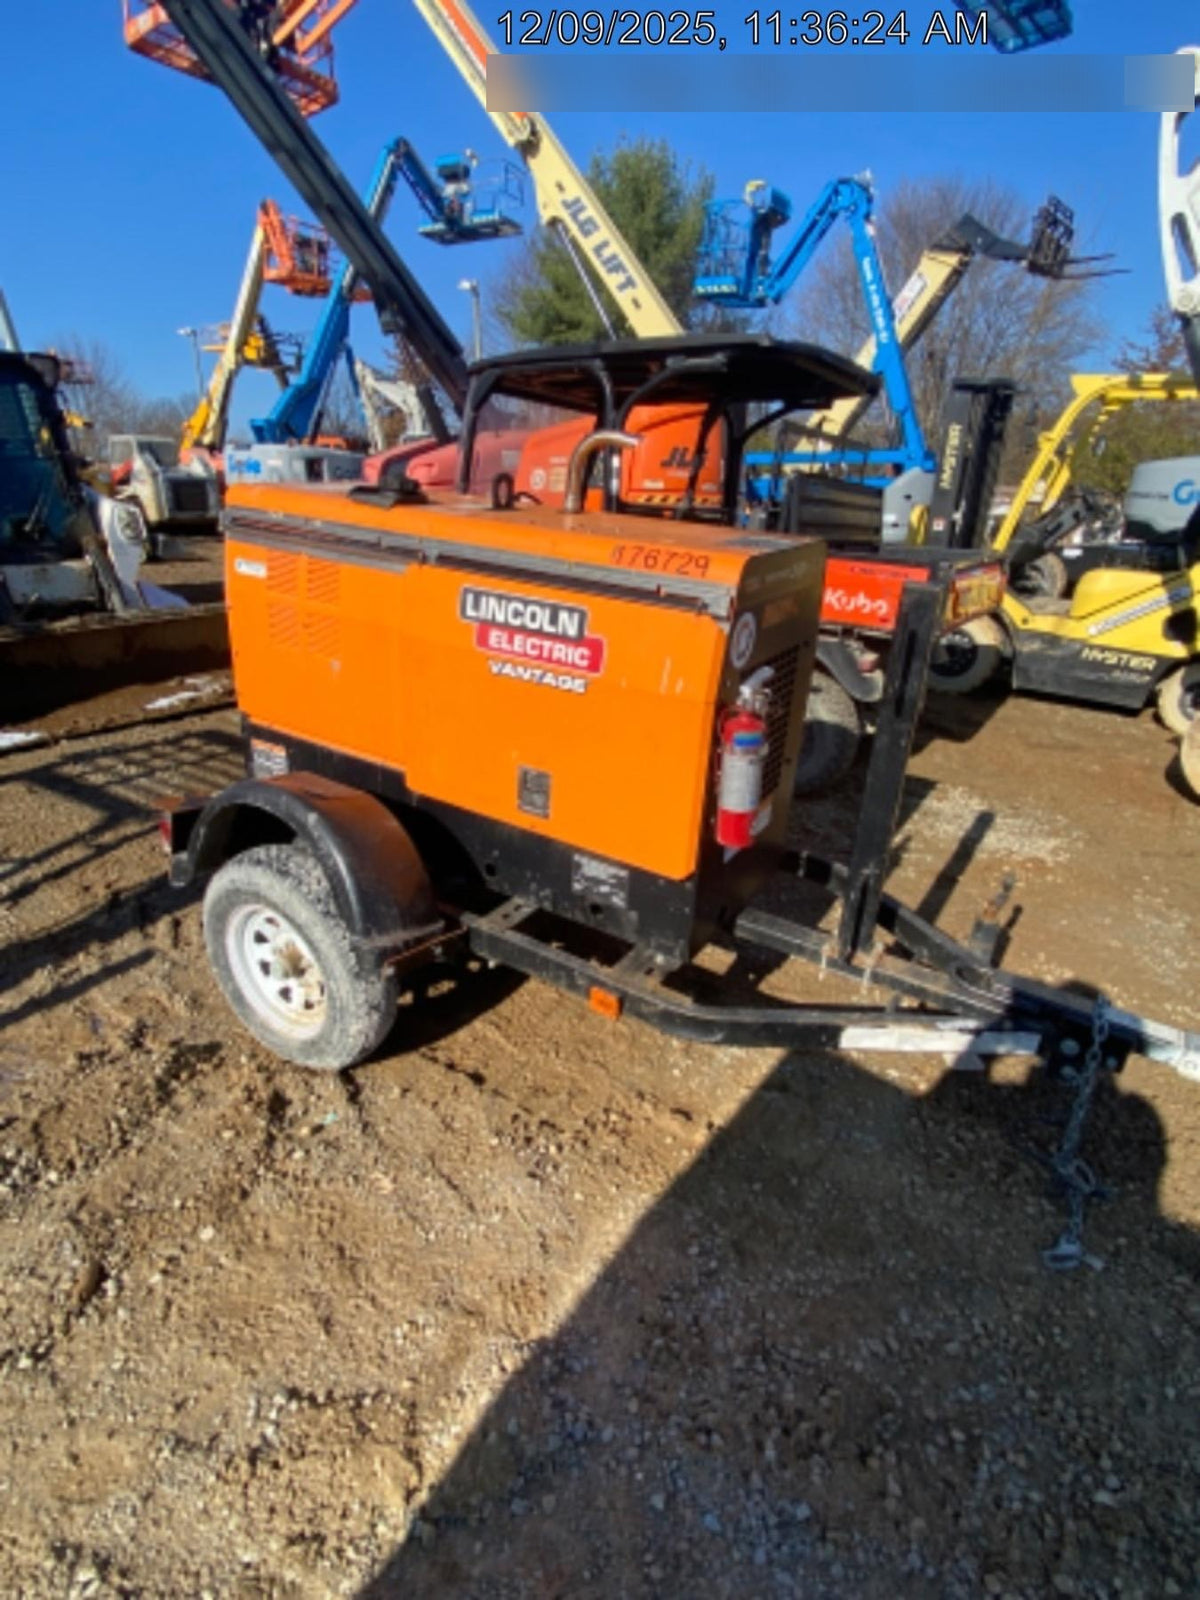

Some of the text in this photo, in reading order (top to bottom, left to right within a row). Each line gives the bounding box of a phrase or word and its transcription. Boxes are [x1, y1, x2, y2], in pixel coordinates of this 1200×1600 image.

[561, 197, 638, 292] JLG LIFT
[465, 592, 579, 638] LINCOLN
[488, 629, 591, 667] ELECTRIC
[488, 659, 587, 693] VANTAGE
